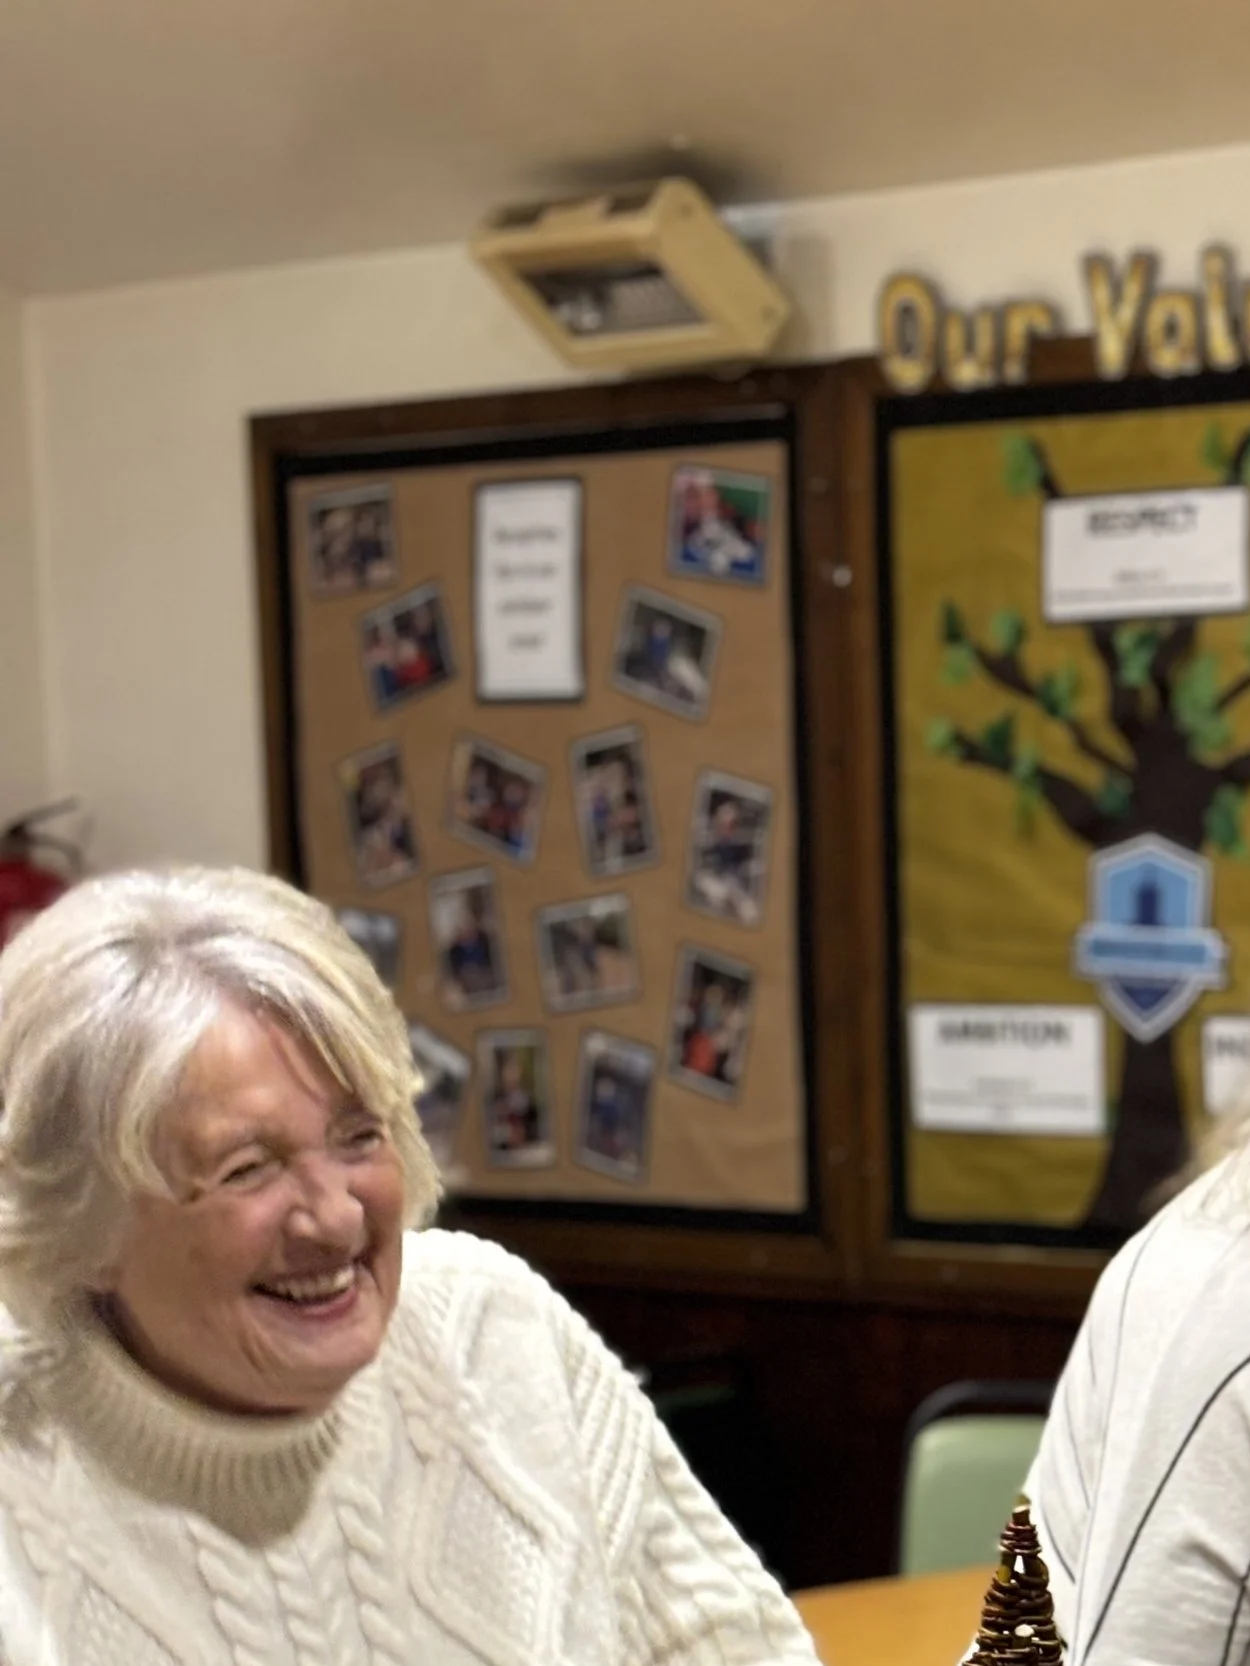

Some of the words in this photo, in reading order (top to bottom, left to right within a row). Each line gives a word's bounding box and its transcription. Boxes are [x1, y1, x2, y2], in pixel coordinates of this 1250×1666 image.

[879, 267, 1057, 394] Our
[1087, 504, 1198, 537] RESPECT
[938, 1020, 1071, 1050] AMBITION
